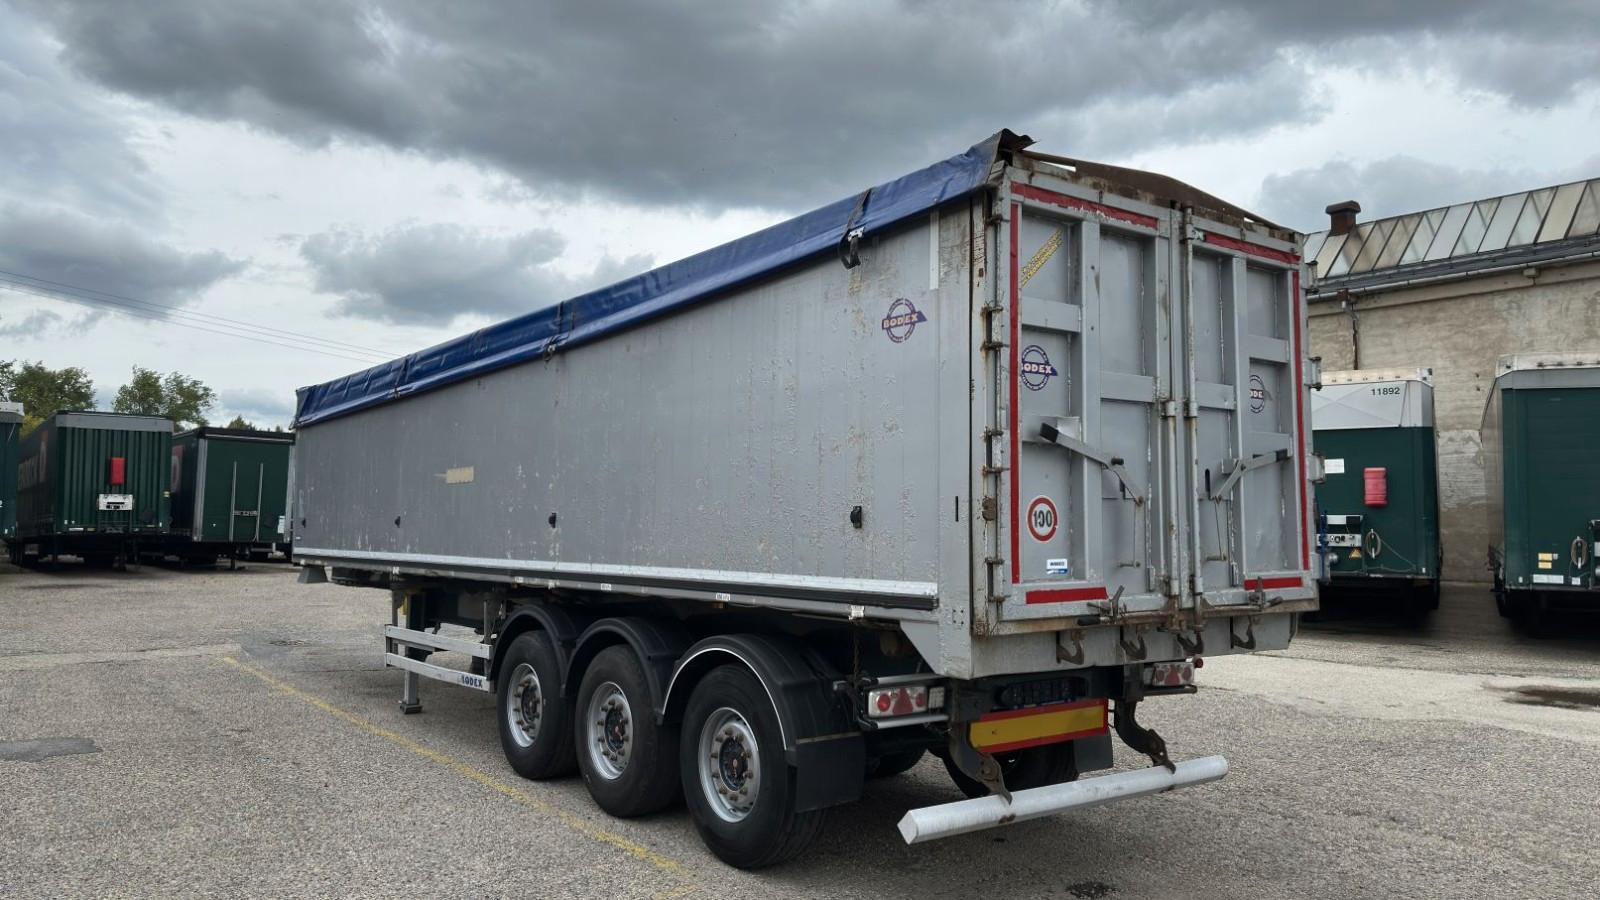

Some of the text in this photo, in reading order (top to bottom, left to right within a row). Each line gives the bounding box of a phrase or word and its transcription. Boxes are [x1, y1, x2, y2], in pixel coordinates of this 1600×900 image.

[883, 312, 918, 328] BODEX
[1022, 362, 1052, 374] ODEX
[1370, 387, 1400, 395] 11892
[1034, 510, 1053, 528] 100
